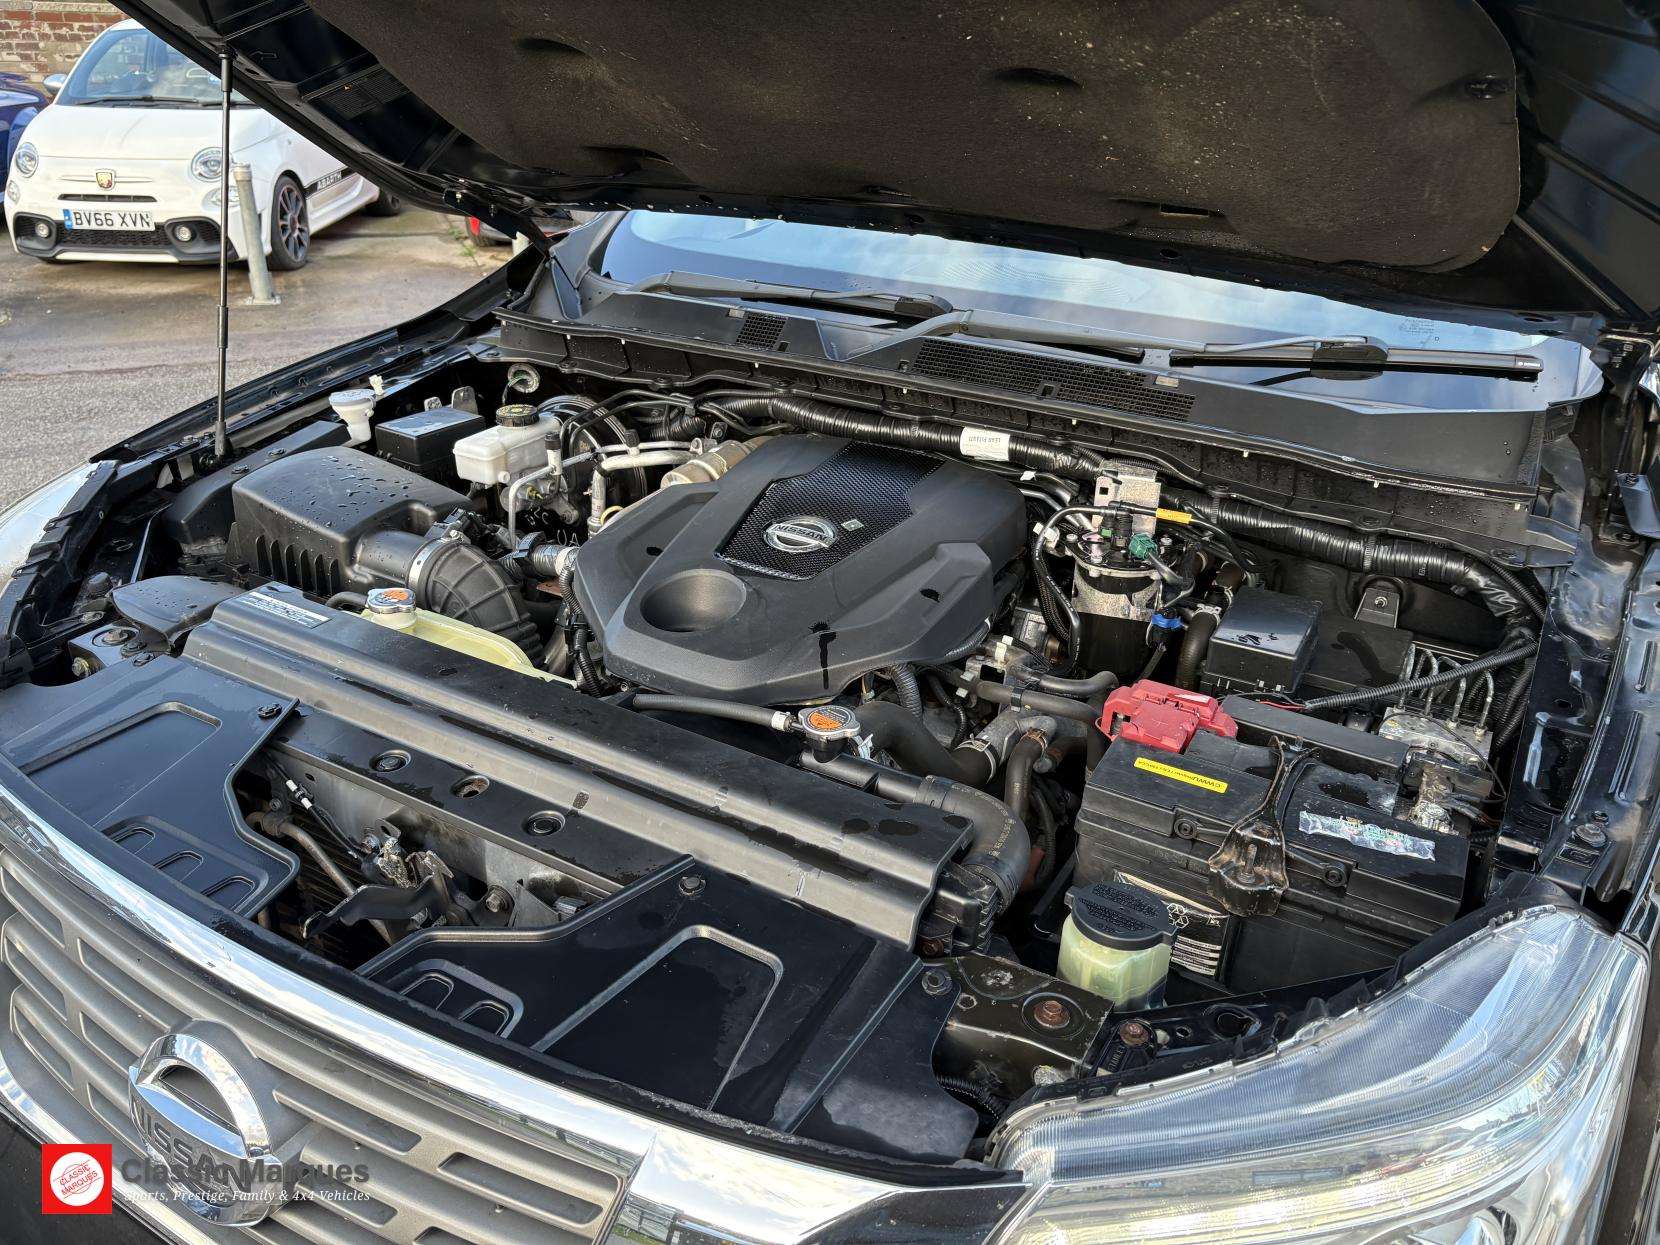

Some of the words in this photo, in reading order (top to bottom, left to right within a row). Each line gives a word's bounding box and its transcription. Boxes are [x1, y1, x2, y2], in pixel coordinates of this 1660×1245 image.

[73, 211, 114, 227] BV66
[118, 212, 151, 228] XVN
[774, 524, 830, 541] NISSAN
